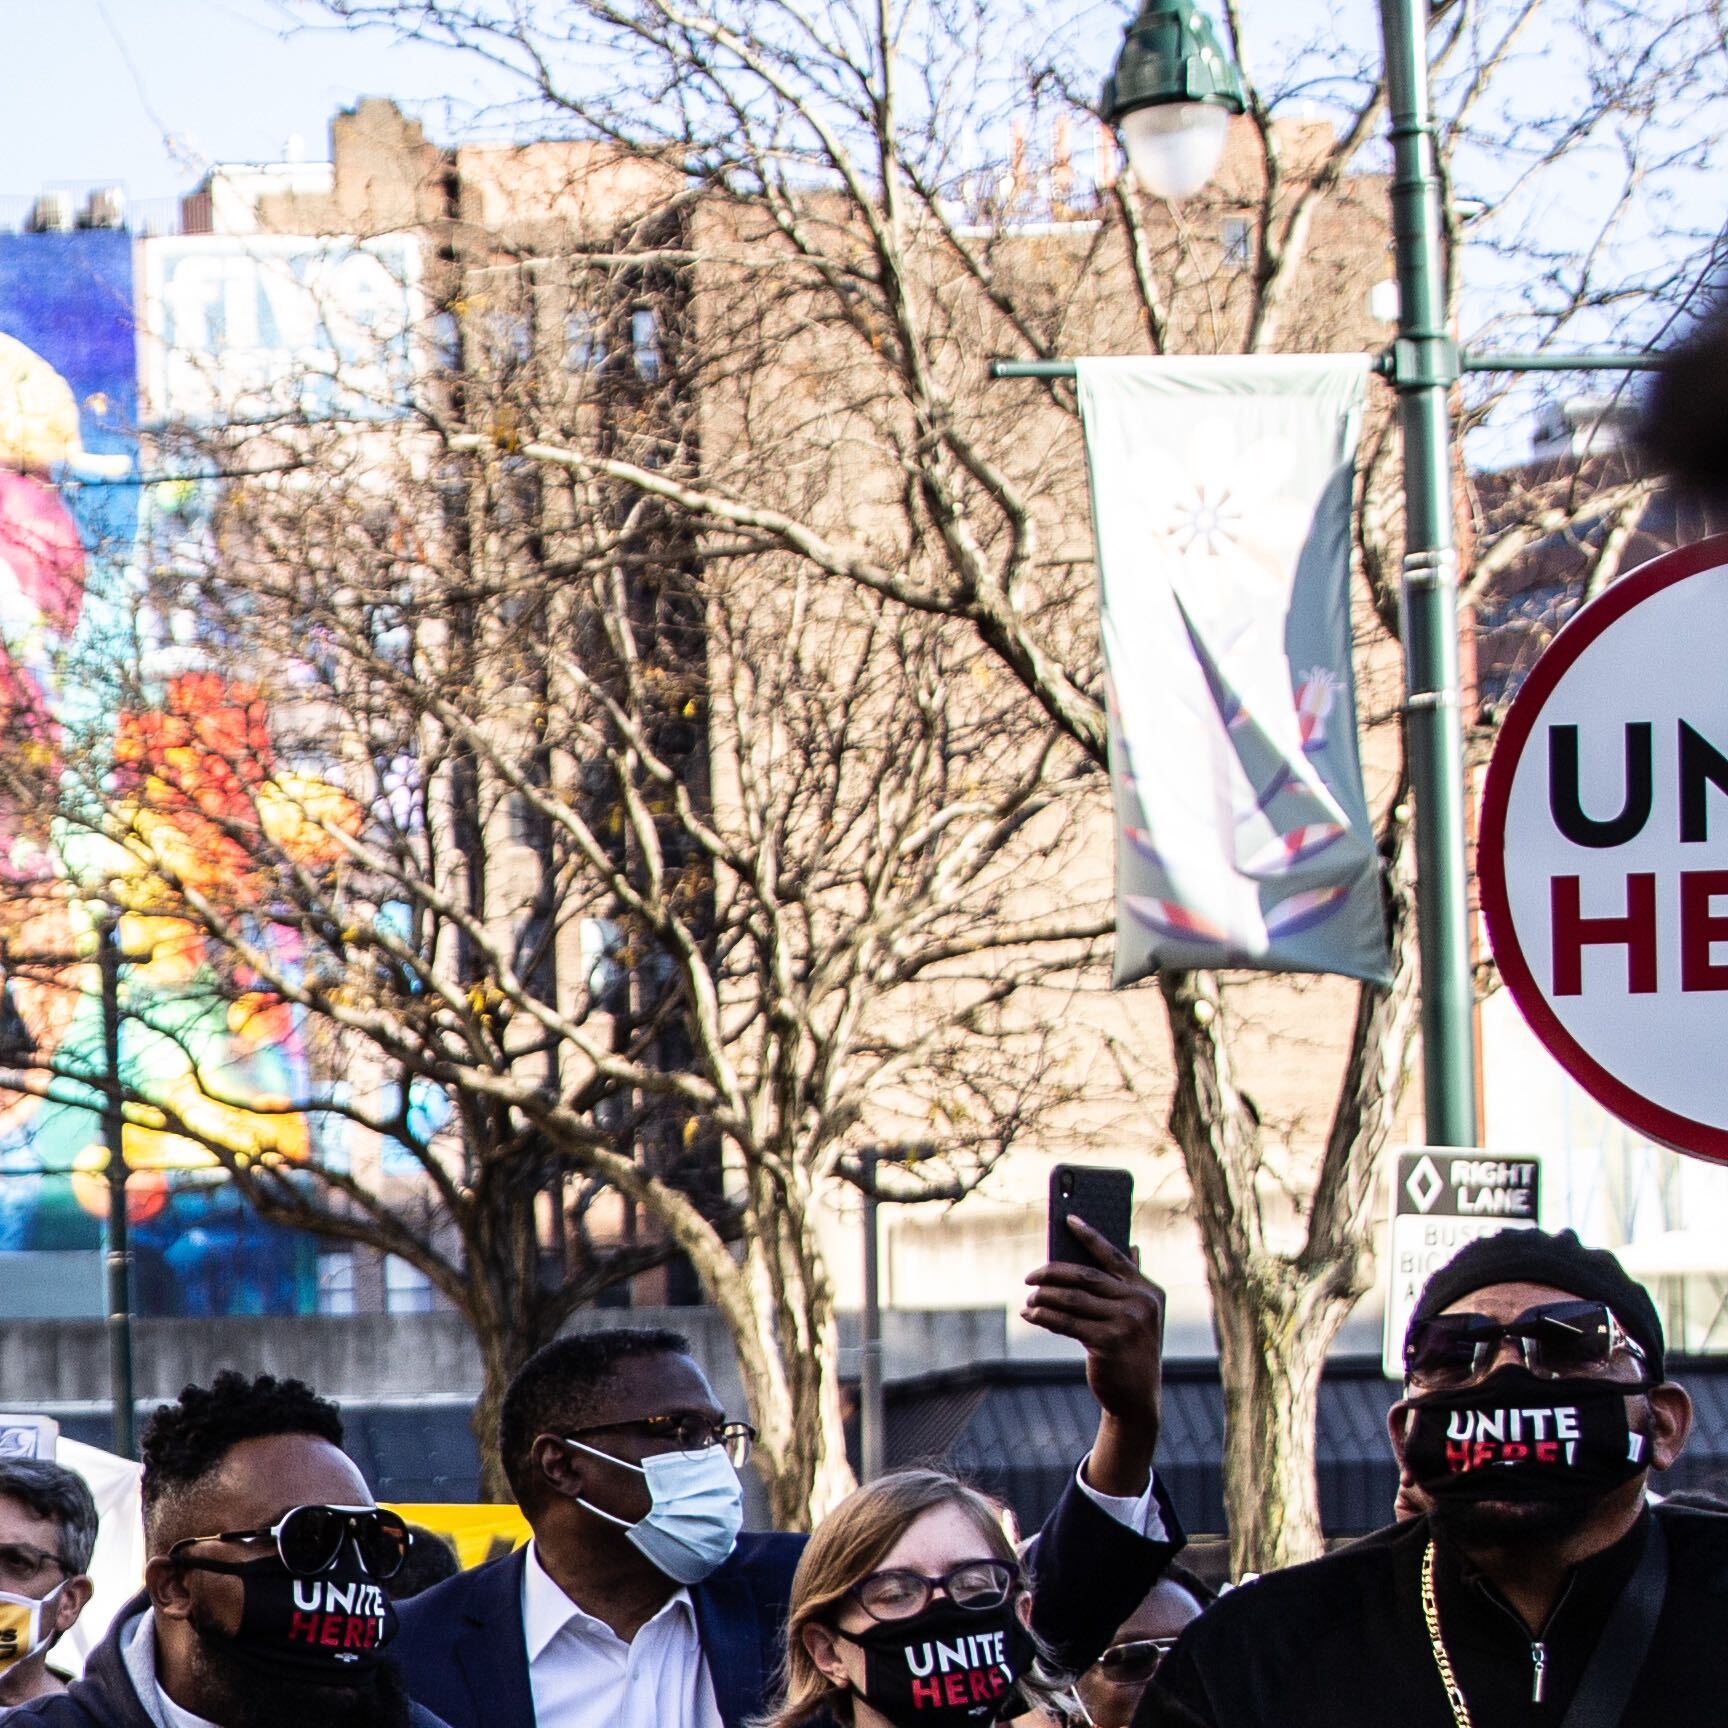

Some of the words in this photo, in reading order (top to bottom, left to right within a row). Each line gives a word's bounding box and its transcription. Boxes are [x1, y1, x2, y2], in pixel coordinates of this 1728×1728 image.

[1450, 1160, 1536, 1187] RIGHT
[1457, 1186, 1530, 1214] LANE
[1446, 1407, 1581, 1442] UNITE
[293, 1579, 386, 1616] UNITE
[288, 1611, 384, 1649] HERE!
[905, 1631, 1007, 1678] UNITE
[911, 1661, 1016, 1710] HERE!
